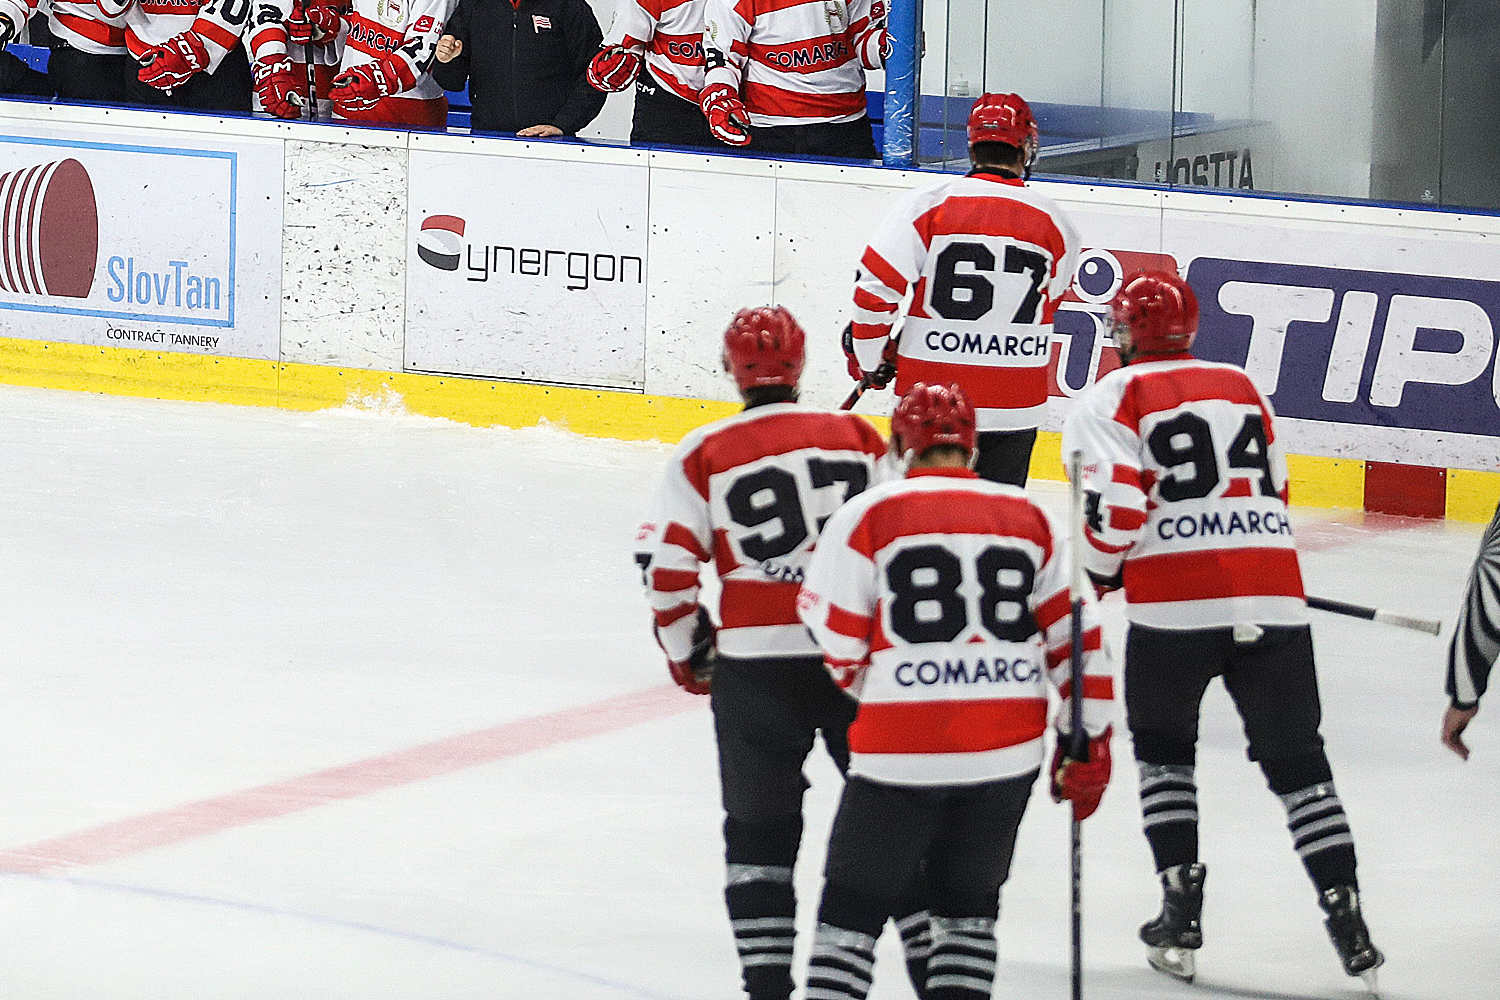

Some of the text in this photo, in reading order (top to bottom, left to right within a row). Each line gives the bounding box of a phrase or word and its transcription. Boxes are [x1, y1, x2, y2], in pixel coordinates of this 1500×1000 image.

[346, 22, 400, 55] MARCH
[369, 61, 389, 98] CCM
[635, 81, 656, 97] CM
[106, 255, 221, 310] SlovTan
[929, 241, 1048, 324] 67
[106, 327, 220, 348] CONTRACT TANNERY
[925, 330, 1049, 357] COMARCH
[1218, 280, 1500, 408] TIP
[1147, 410, 1280, 503] 94
[724, 456, 868, 563] 97
[1157, 510, 1293, 540] COMARCH
[885, 544, 1040, 644] 88
[894, 657, 1043, 687] COMARCH
